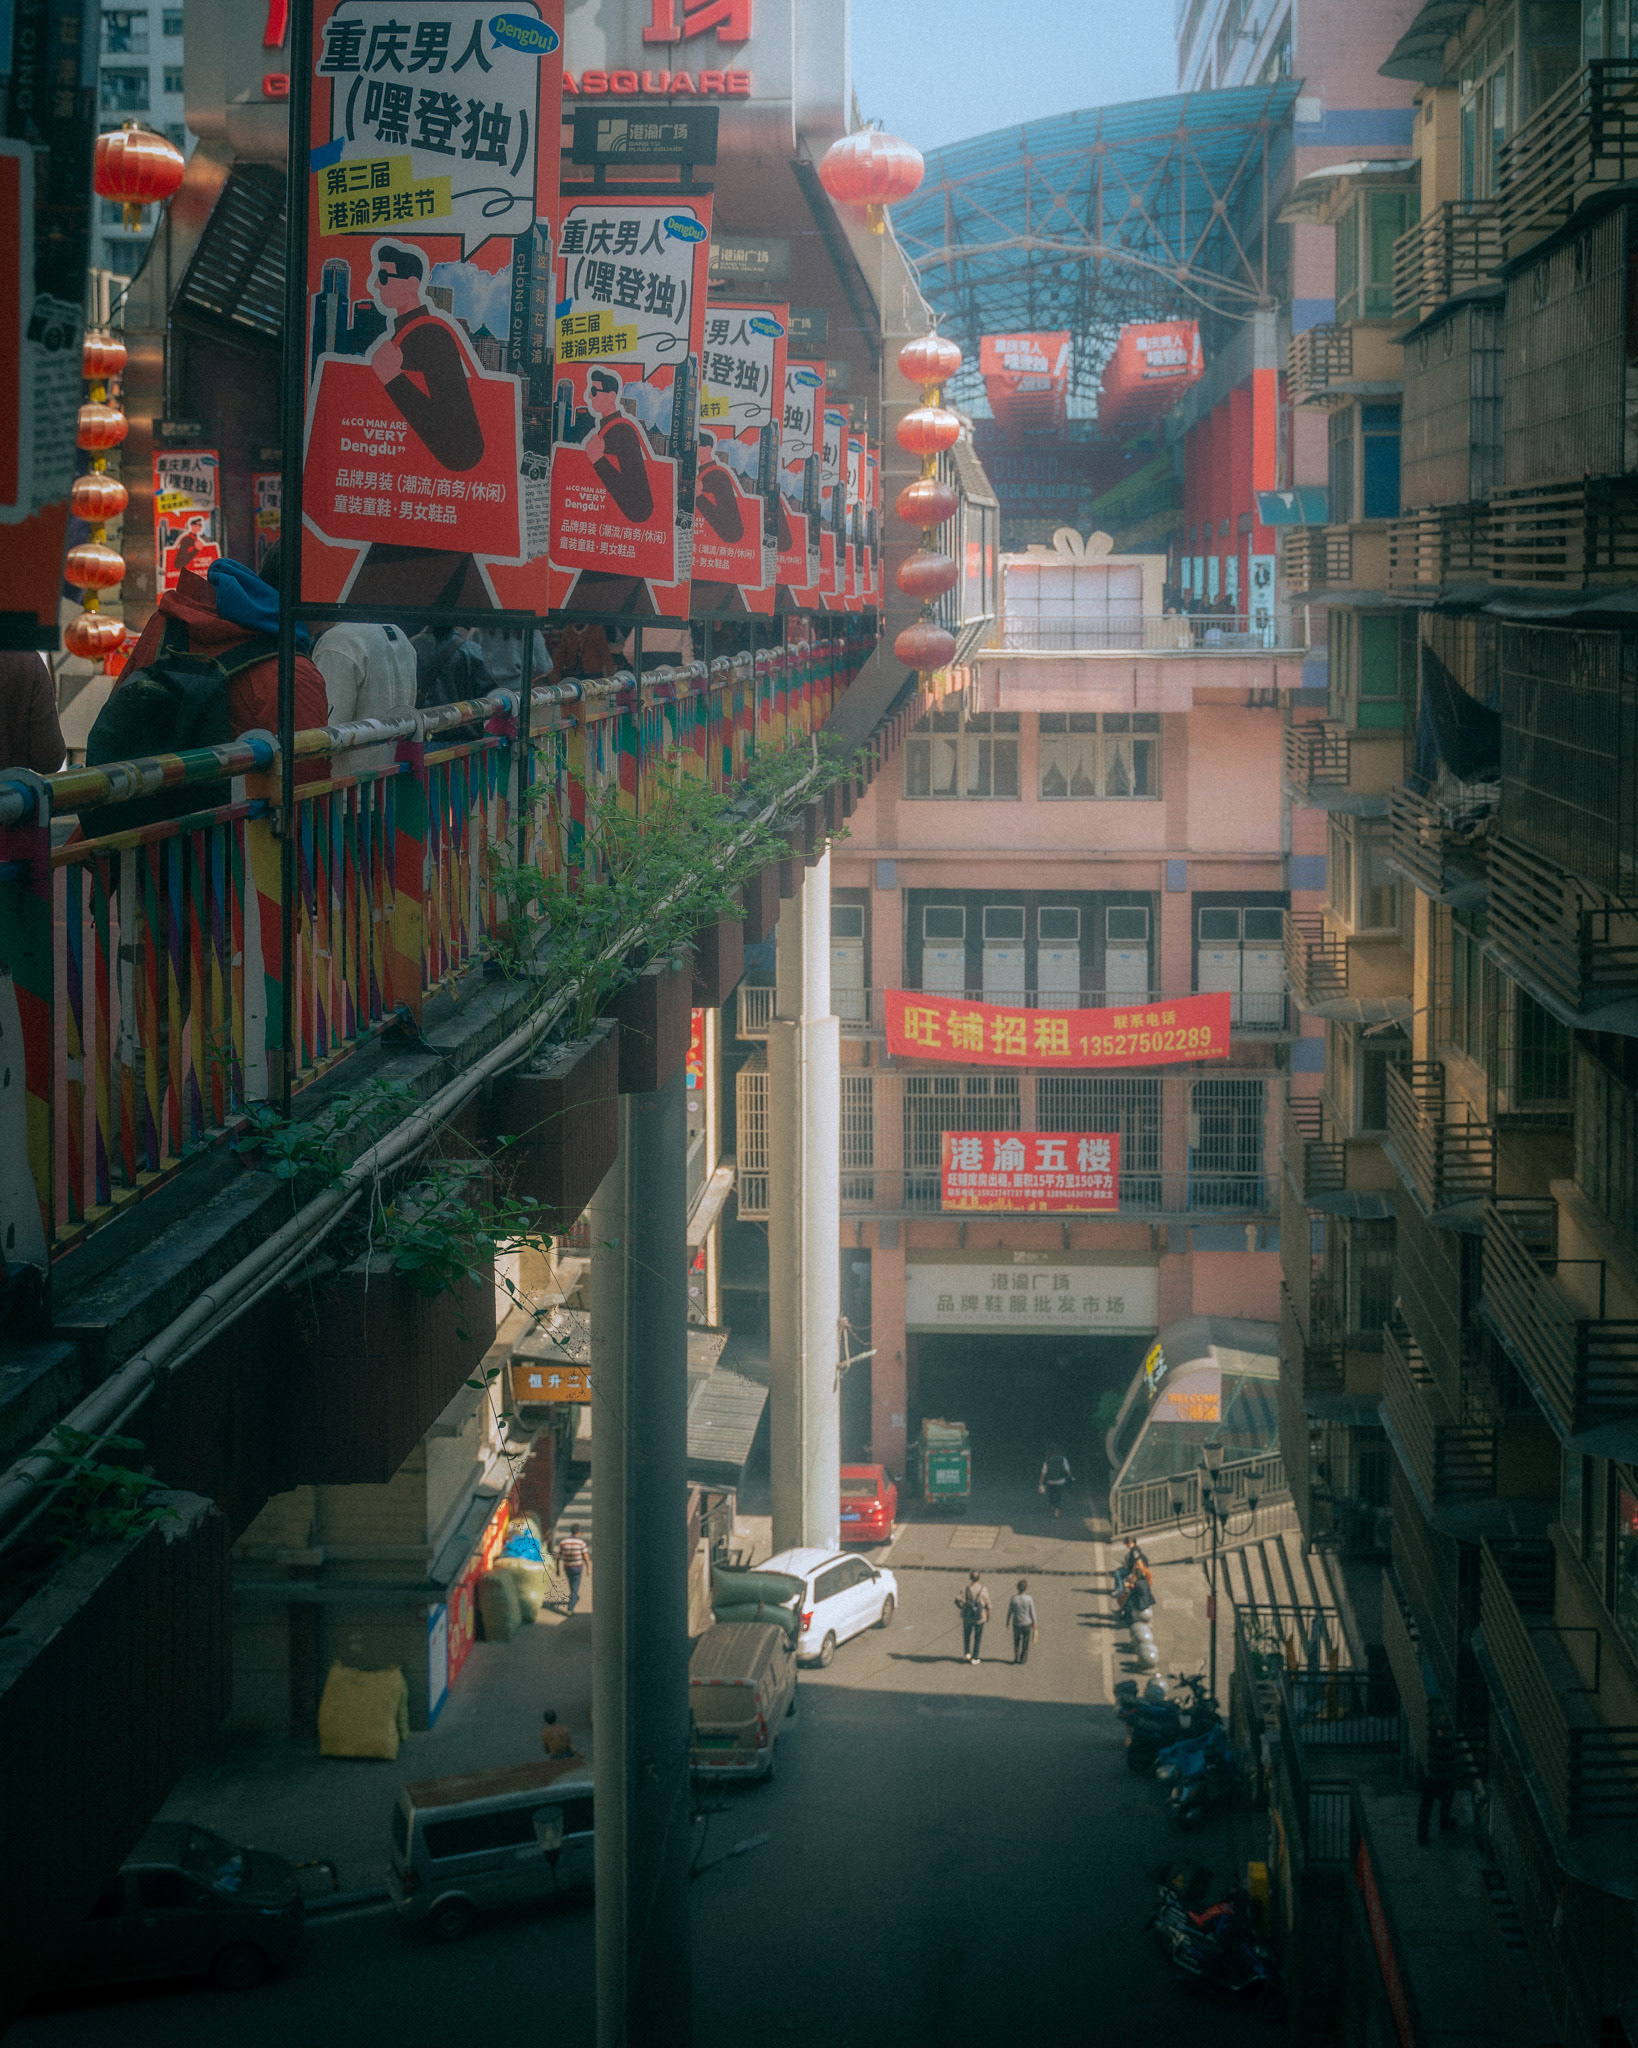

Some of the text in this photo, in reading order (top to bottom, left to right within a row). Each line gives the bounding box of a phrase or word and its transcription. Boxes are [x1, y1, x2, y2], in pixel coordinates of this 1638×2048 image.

[320, 19, 492, 74] 重庆男人
[495, 18, 553, 51] DengDu!
[346, 74, 529, 177] (嘿登独)
[629, 124, 688, 140] 港渝广场
[327, 162, 390, 195] 第三届
[328, 189, 435, 230] 港渝男装节
[560, 219, 666, 256] 重庆男人
[667, 217, 704, 241] DengDu!
[573, 256, 687, 325] (嘿登独)
[512, 253, 526, 360] CHONG QING
[561, 314, 600, 337] 第三届
[704, 319, 751, 346] 男人
[561, 333, 627, 359] 港渝男装节
[364, 428, 407, 442] VERY
[366, 418, 388, 429] MAN
[389, 421, 408, 430] ARE
[579, 493, 606, 503] VERY
[904, 1006, 1176, 1057] 旺铺招租 联系电话
[1080, 1026, 1211, 1057] 13527502289
[950, 1137, 1111, 1173] 港渝五楼
[991, 1273, 1070, 1291] 港渝广场
[937, 1294, 1125, 1313] 品牌鞋服批发市场
[529, 1373, 591, 1388] 恒升二
